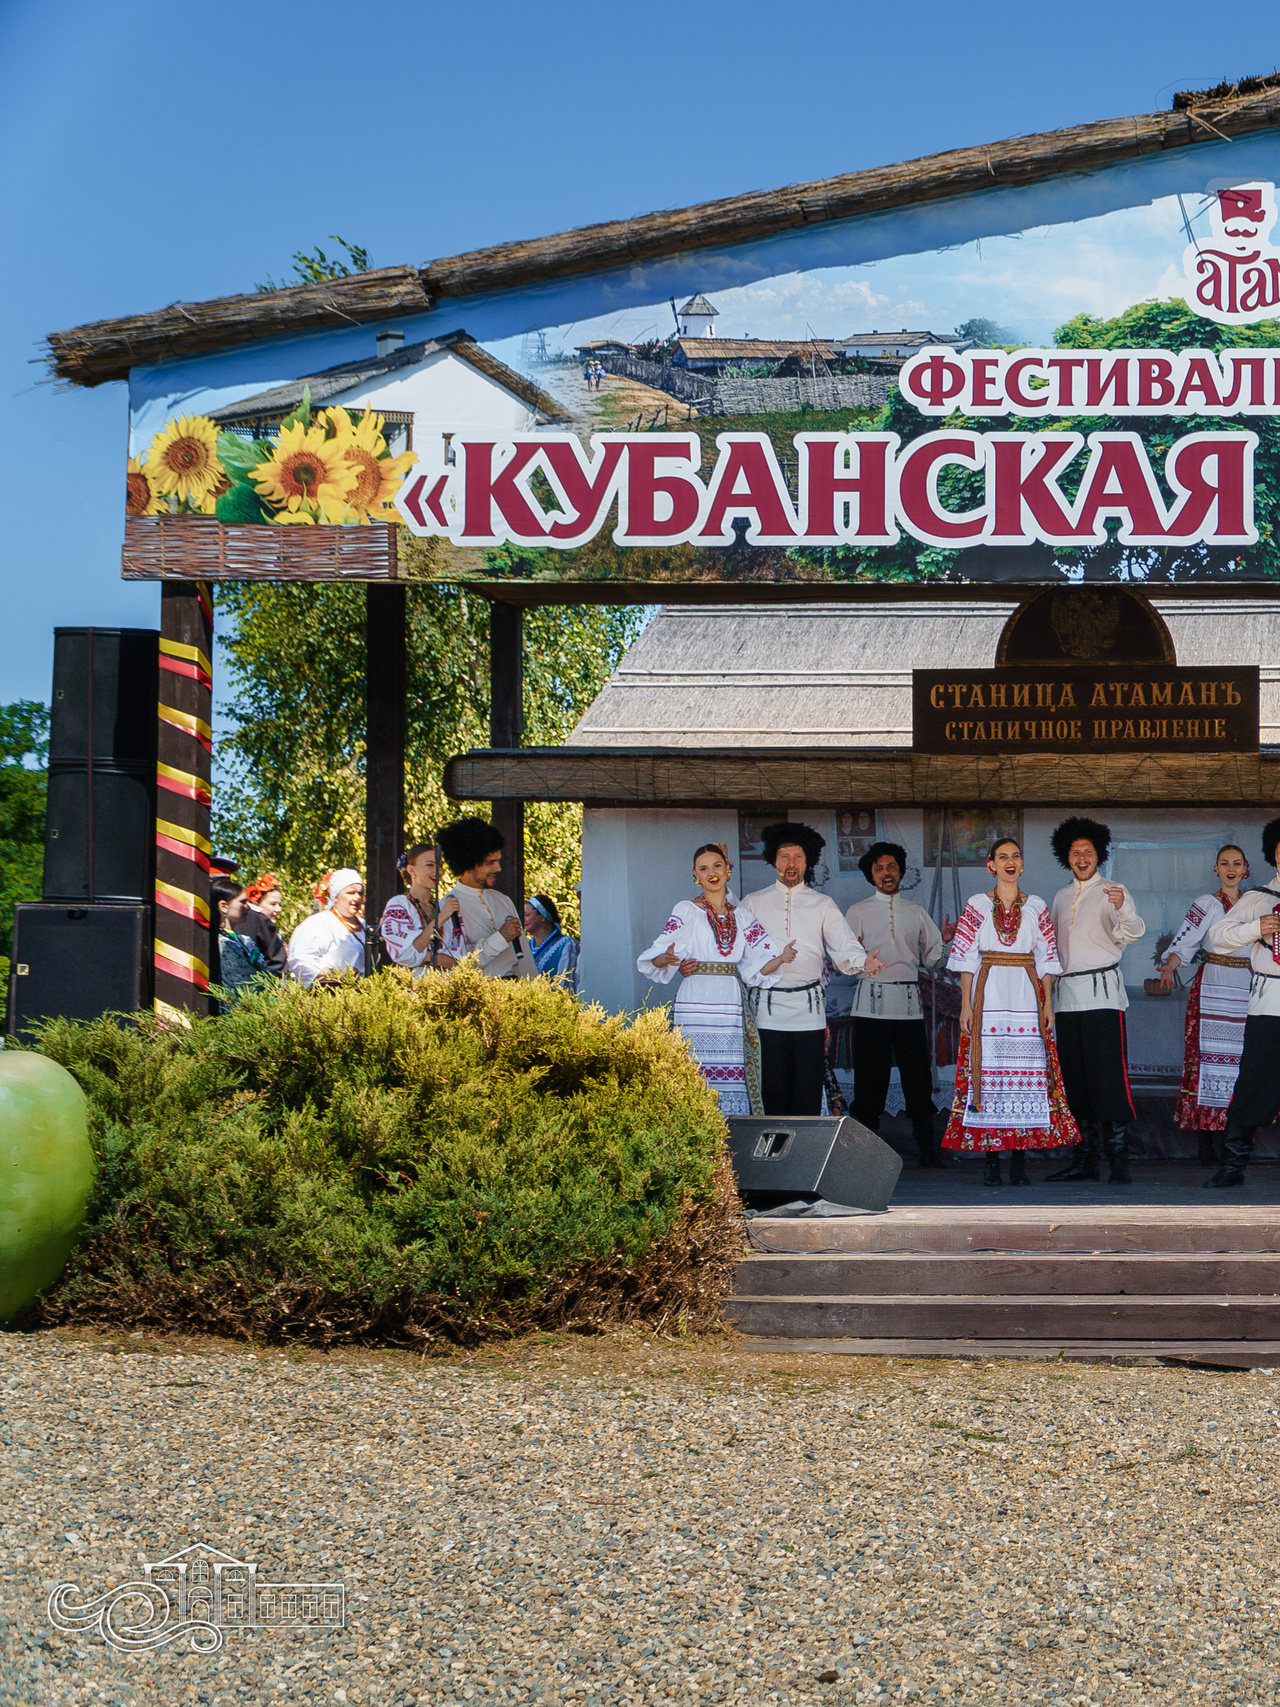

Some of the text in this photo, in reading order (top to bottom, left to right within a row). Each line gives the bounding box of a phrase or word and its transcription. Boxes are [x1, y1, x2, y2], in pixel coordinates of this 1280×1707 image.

[403, 438, 1247, 539] «КУБАНСКАЯ
[930, 680, 1243, 713] СТАНИЦА АТАМАНЪ
[945, 719, 1082, 741] СТАНИЧНОЕ
